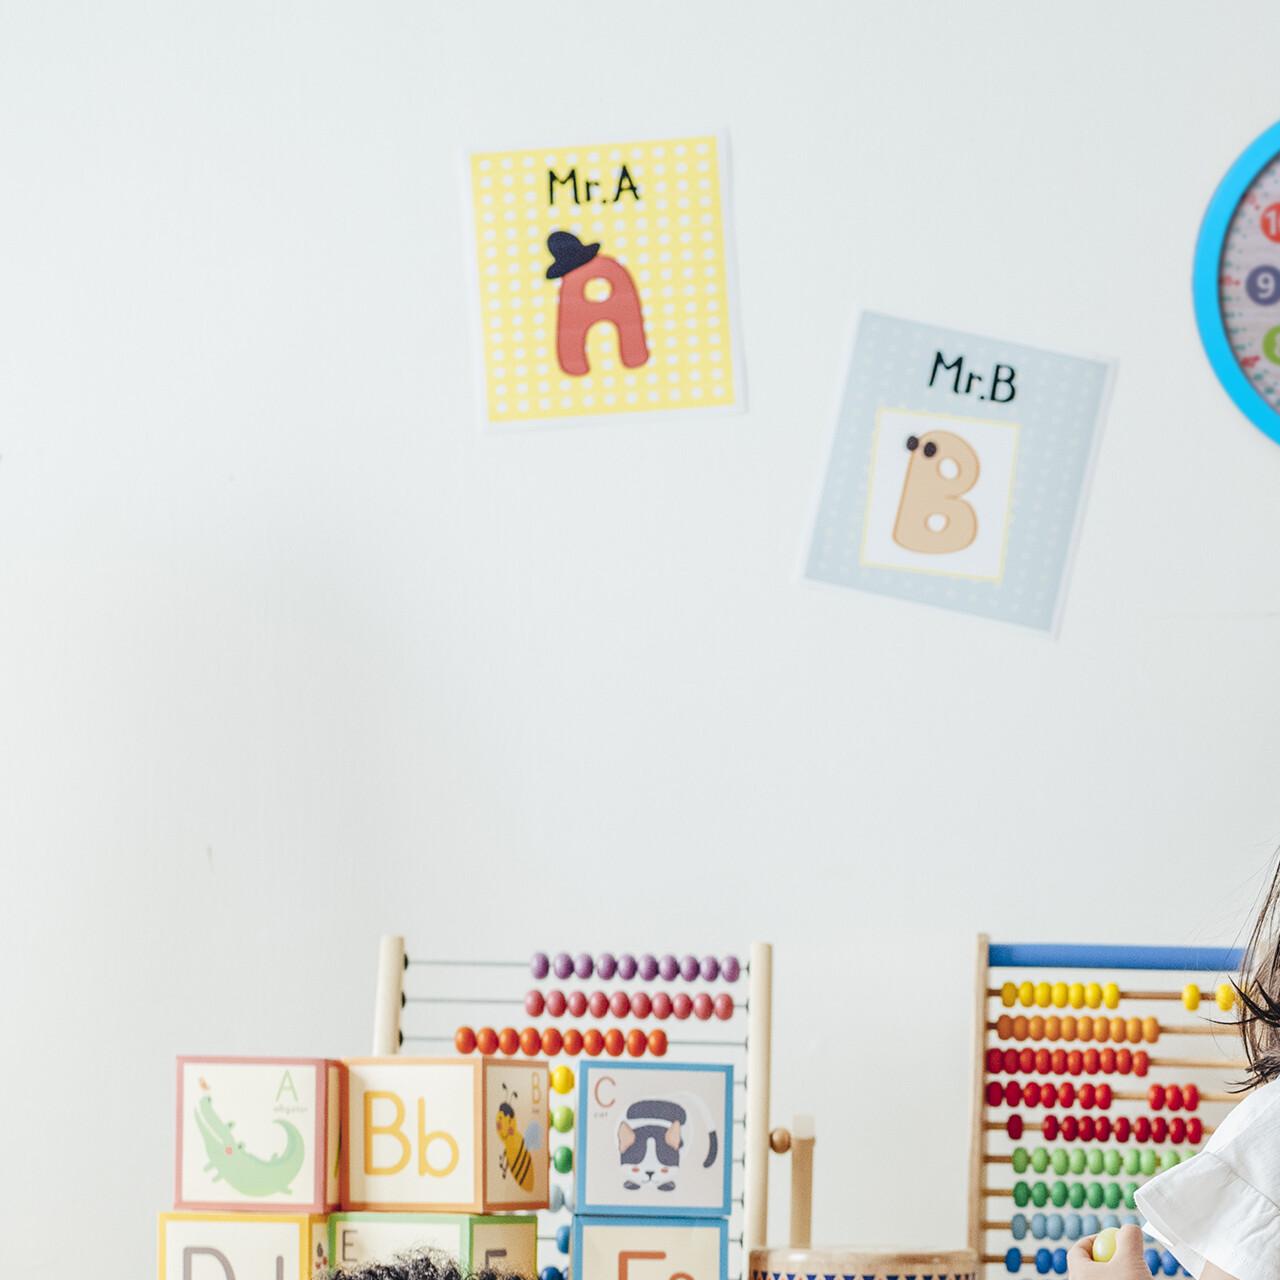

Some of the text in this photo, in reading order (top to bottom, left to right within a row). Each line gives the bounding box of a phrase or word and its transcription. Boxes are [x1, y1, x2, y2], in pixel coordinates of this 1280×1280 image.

[547, 165, 640, 205] Mr.A
[1257, 273, 1275, 298] 9
[555, 254, 650, 377] A
[928, 351, 1016, 403] Mr.B
[892, 430, 980, 555] B
[275, 1069, 299, 1103] A
[531, 1071, 541, 1104] B
[594, 1076, 616, 1109] C
[363, 1090, 460, 1177] Bb
[342, 1229, 359, 1262] E
